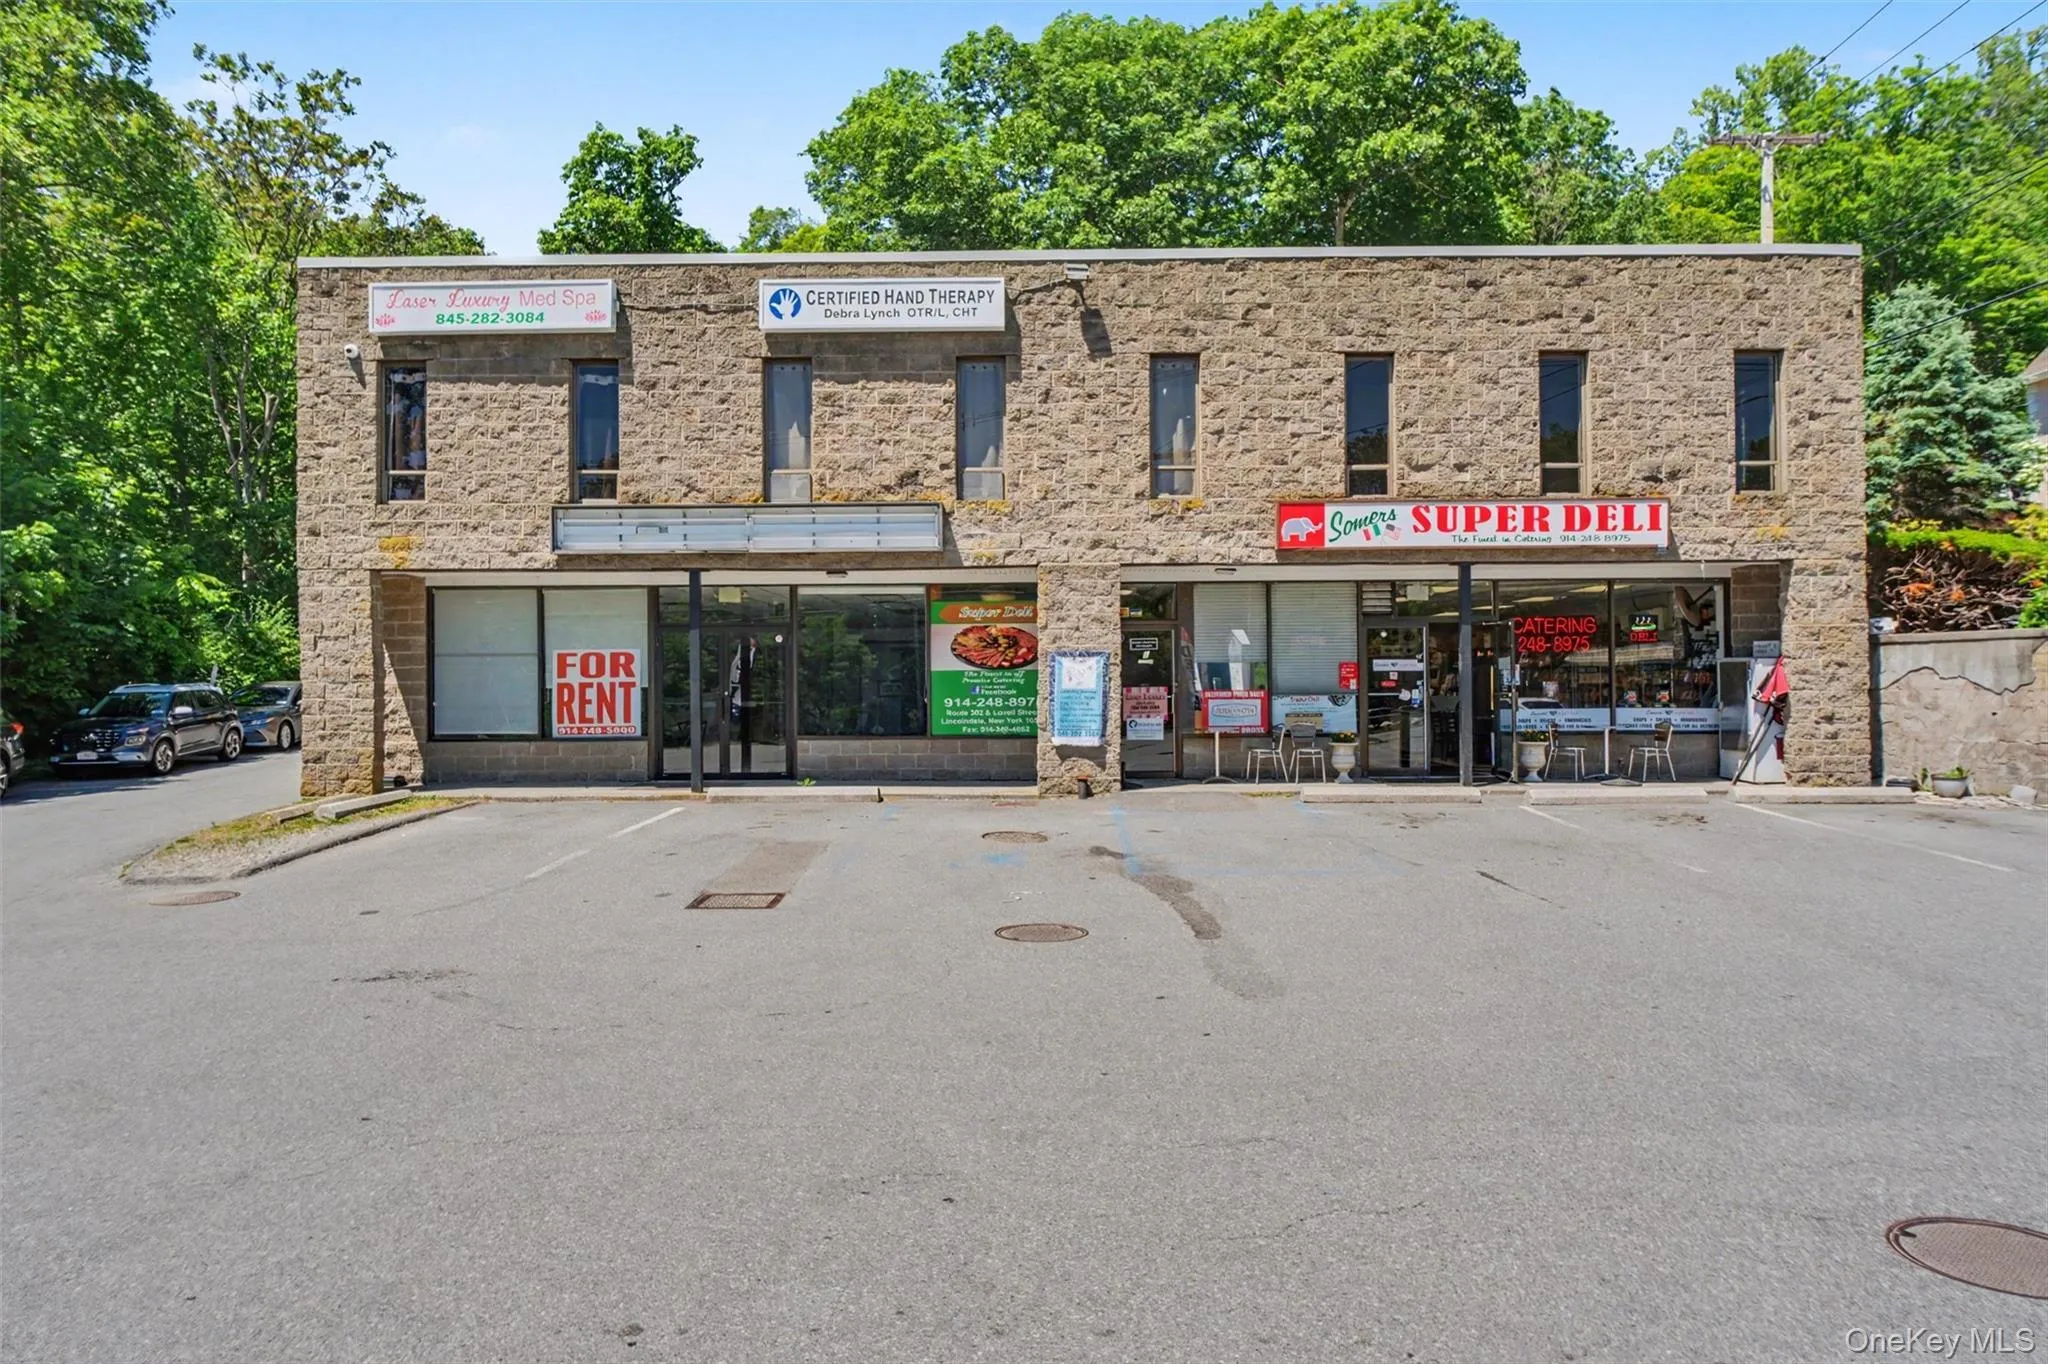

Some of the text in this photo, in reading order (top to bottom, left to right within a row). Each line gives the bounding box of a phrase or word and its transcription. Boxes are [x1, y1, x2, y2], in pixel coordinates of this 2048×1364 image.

[386, 287, 596, 312] Laser Luxury Med Spa
[806, 288, 995, 305] CERTIFIED HAND THERAPY
[435, 312, 545, 325] 845-282-3084
[824, 307, 860, 319] Debra
[864, 307, 900, 321] Lynch
[953, 307, 978, 318] CHT
[1328, 504, 1662, 543] Somers SUPER DELI
[1452, 535, 1468, 543] The
[958, 606, 1034, 621] Super Deli
[1512, 616, 1597, 635] CATERING
[1518, 636, 1591, 653] 248-8975
[556, 651, 636, 679] FOR
[556, 681, 637, 725] RENT
[943, 697, 1036, 708] 914-248-897
